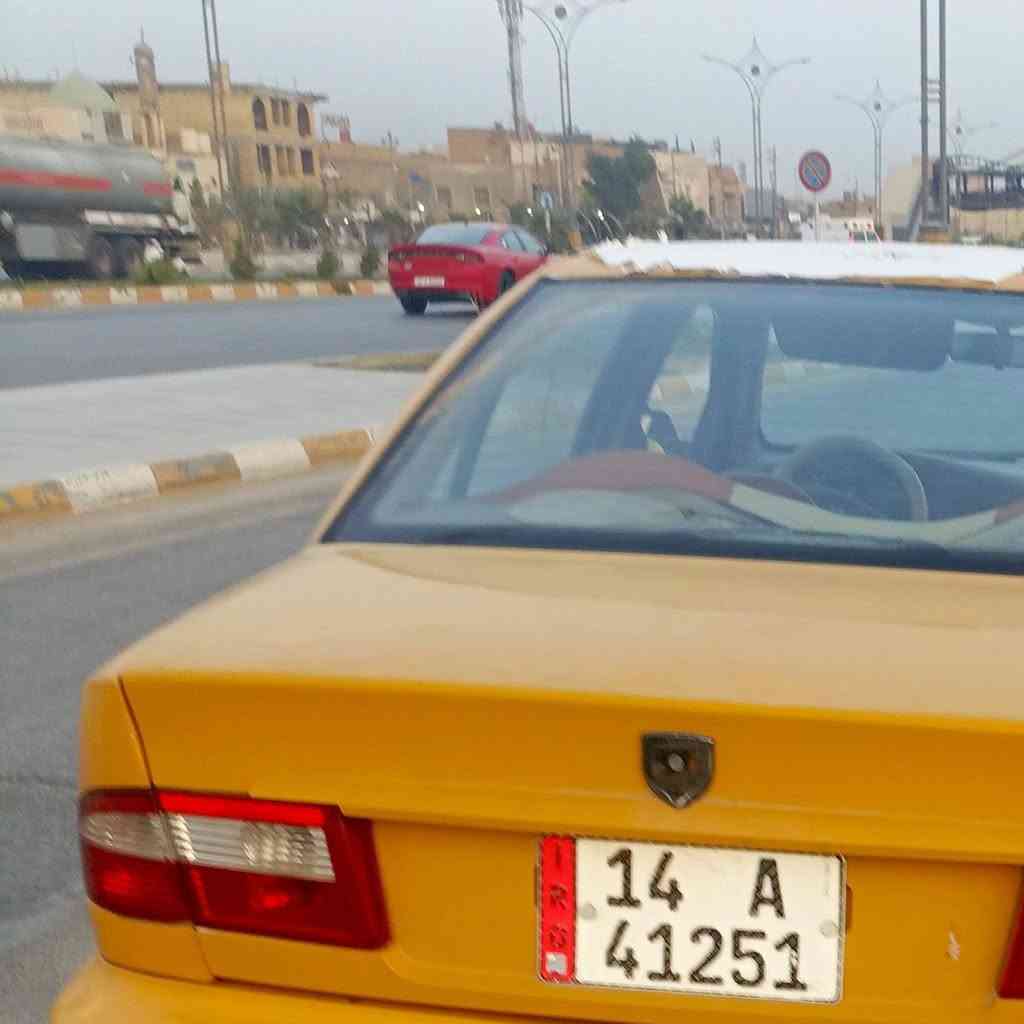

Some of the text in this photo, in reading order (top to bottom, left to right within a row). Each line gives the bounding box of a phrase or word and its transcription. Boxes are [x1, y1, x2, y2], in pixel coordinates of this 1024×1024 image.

[606, 848, 786, 918] 14 A
[604, 920, 808, 991] 41251
